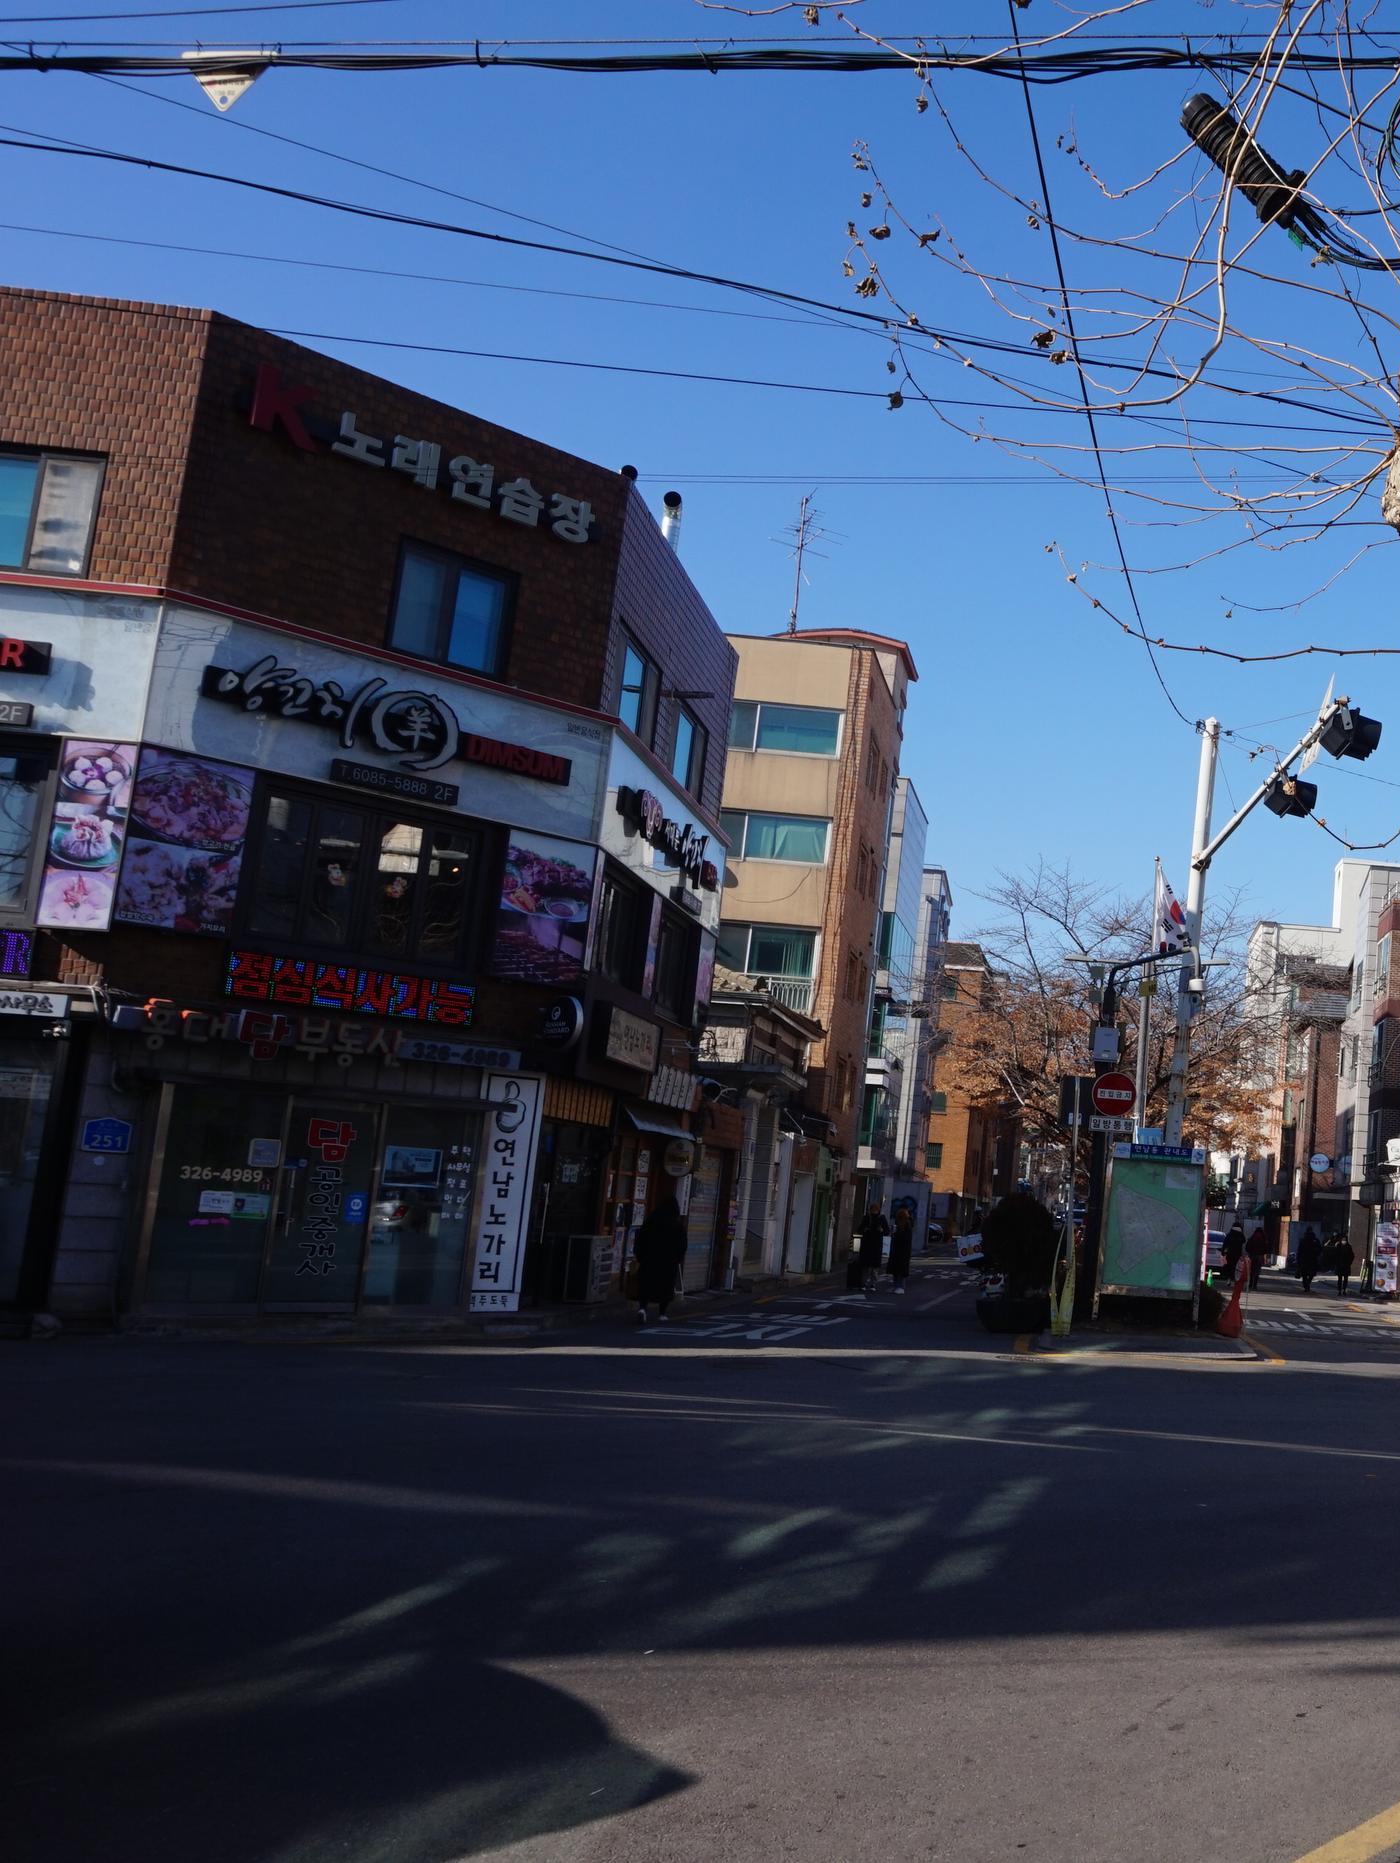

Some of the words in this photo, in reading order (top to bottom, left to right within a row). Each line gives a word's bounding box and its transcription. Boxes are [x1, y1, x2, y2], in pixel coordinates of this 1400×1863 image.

[250, 364, 320, 453] K
[331, 410, 595, 544] 노래연습장
[0, 705, 22, 721] 2F
[466, 734, 566, 781] DIMSUM
[339, 764, 428, 797] T.6085-5888
[434, 784, 453, 801] 2F
[230, 950, 473, 1027] 점심식사가능
[0, 995, 54, 1015] 사무소
[411, 1042, 511, 1067] 326-4989
[1099, 1090, 1132, 1099] 진입금지
[1092, 1118, 1133, 1131] 일방통행
[90, 1134, 124, 1149] 251
[180, 1165, 264, 1183] 326-4989
[295, 1166, 342, 1277] 공인중개사
[479, 1138, 517, 1283] 연남노가리
